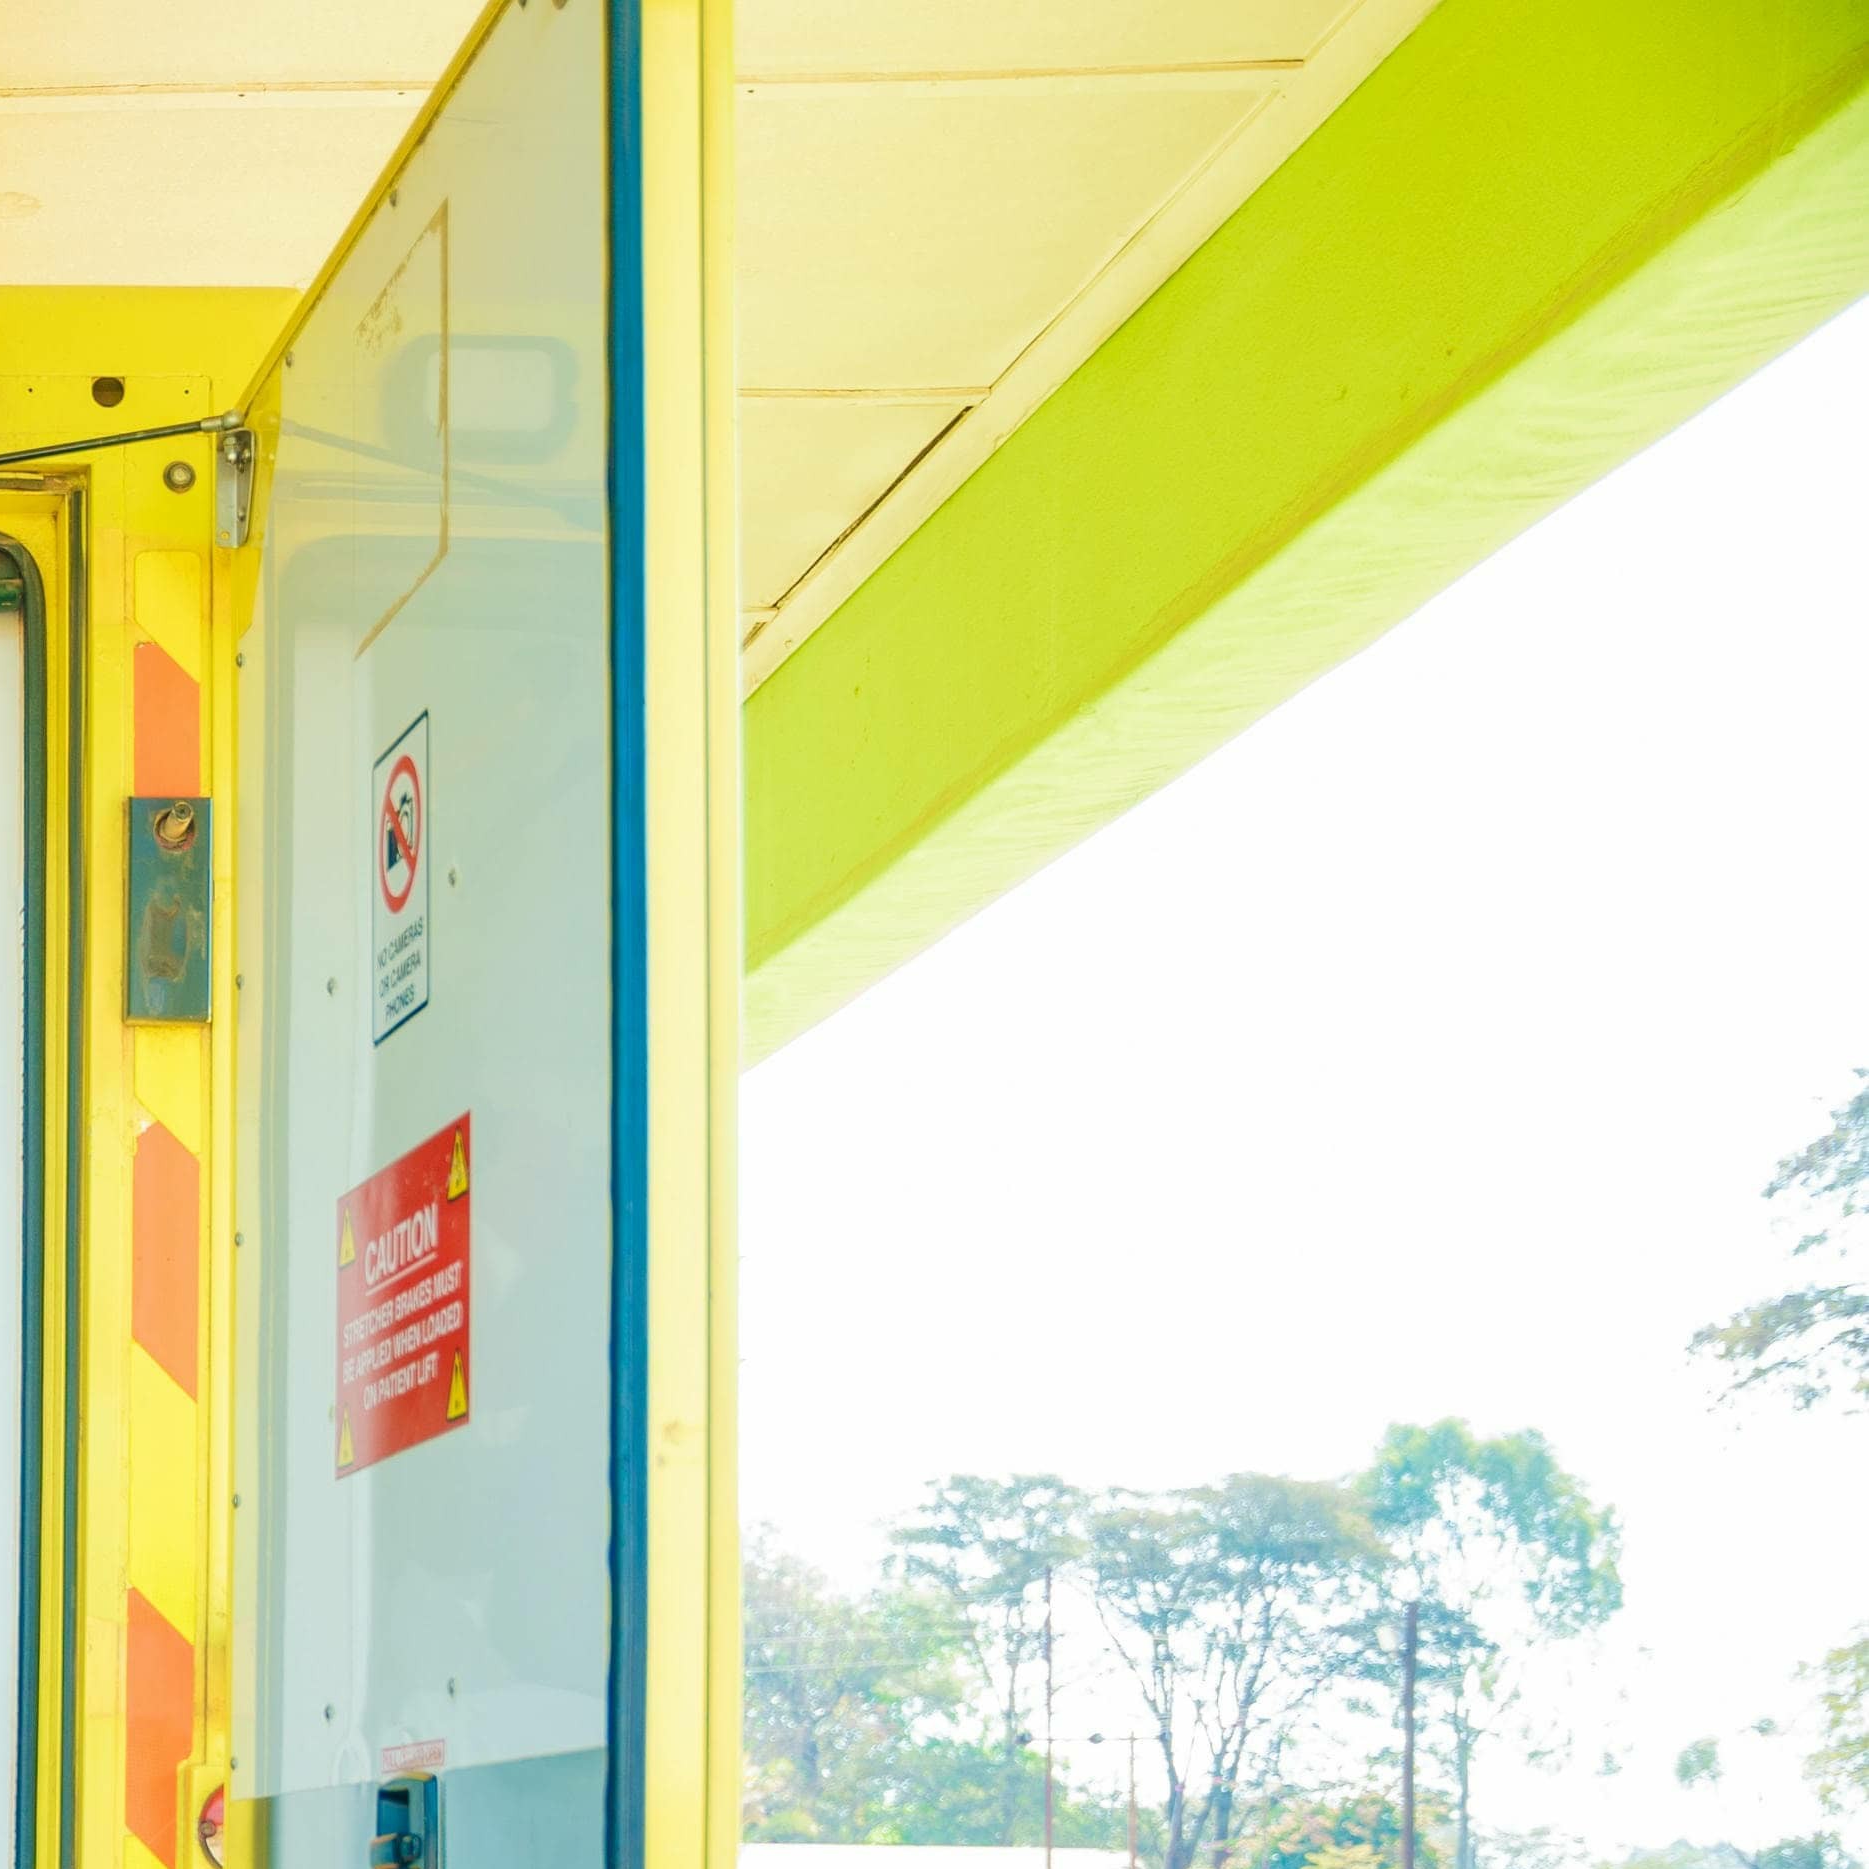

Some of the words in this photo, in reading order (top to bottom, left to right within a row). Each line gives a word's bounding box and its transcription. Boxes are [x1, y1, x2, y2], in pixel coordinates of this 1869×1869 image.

[377, 947, 387, 968] NO
[388, 915, 423, 961] CAMERAS
[379, 975, 389, 998] OR
[391, 949, 421, 988] CAMERA
[385, 983, 415, 1021] PHONES
[364, 1201, 439, 1286] CAUTION
[343, 1300, 394, 1348] STRETCHER
[395, 1277, 431, 1322] BRAKES
[433, 1259, 462, 1300] MUST
[342, 1356, 357, 1385] BE
[357, 1338, 392, 1378] APPLIED
[393, 1324, 420, 1359] WHEN
[421, 1299, 462, 1346] LOADED
[363, 1382, 377, 1410] ON
[377, 1363, 416, 1401] PATIENT
[417, 1351, 439, 1385] LIFT
